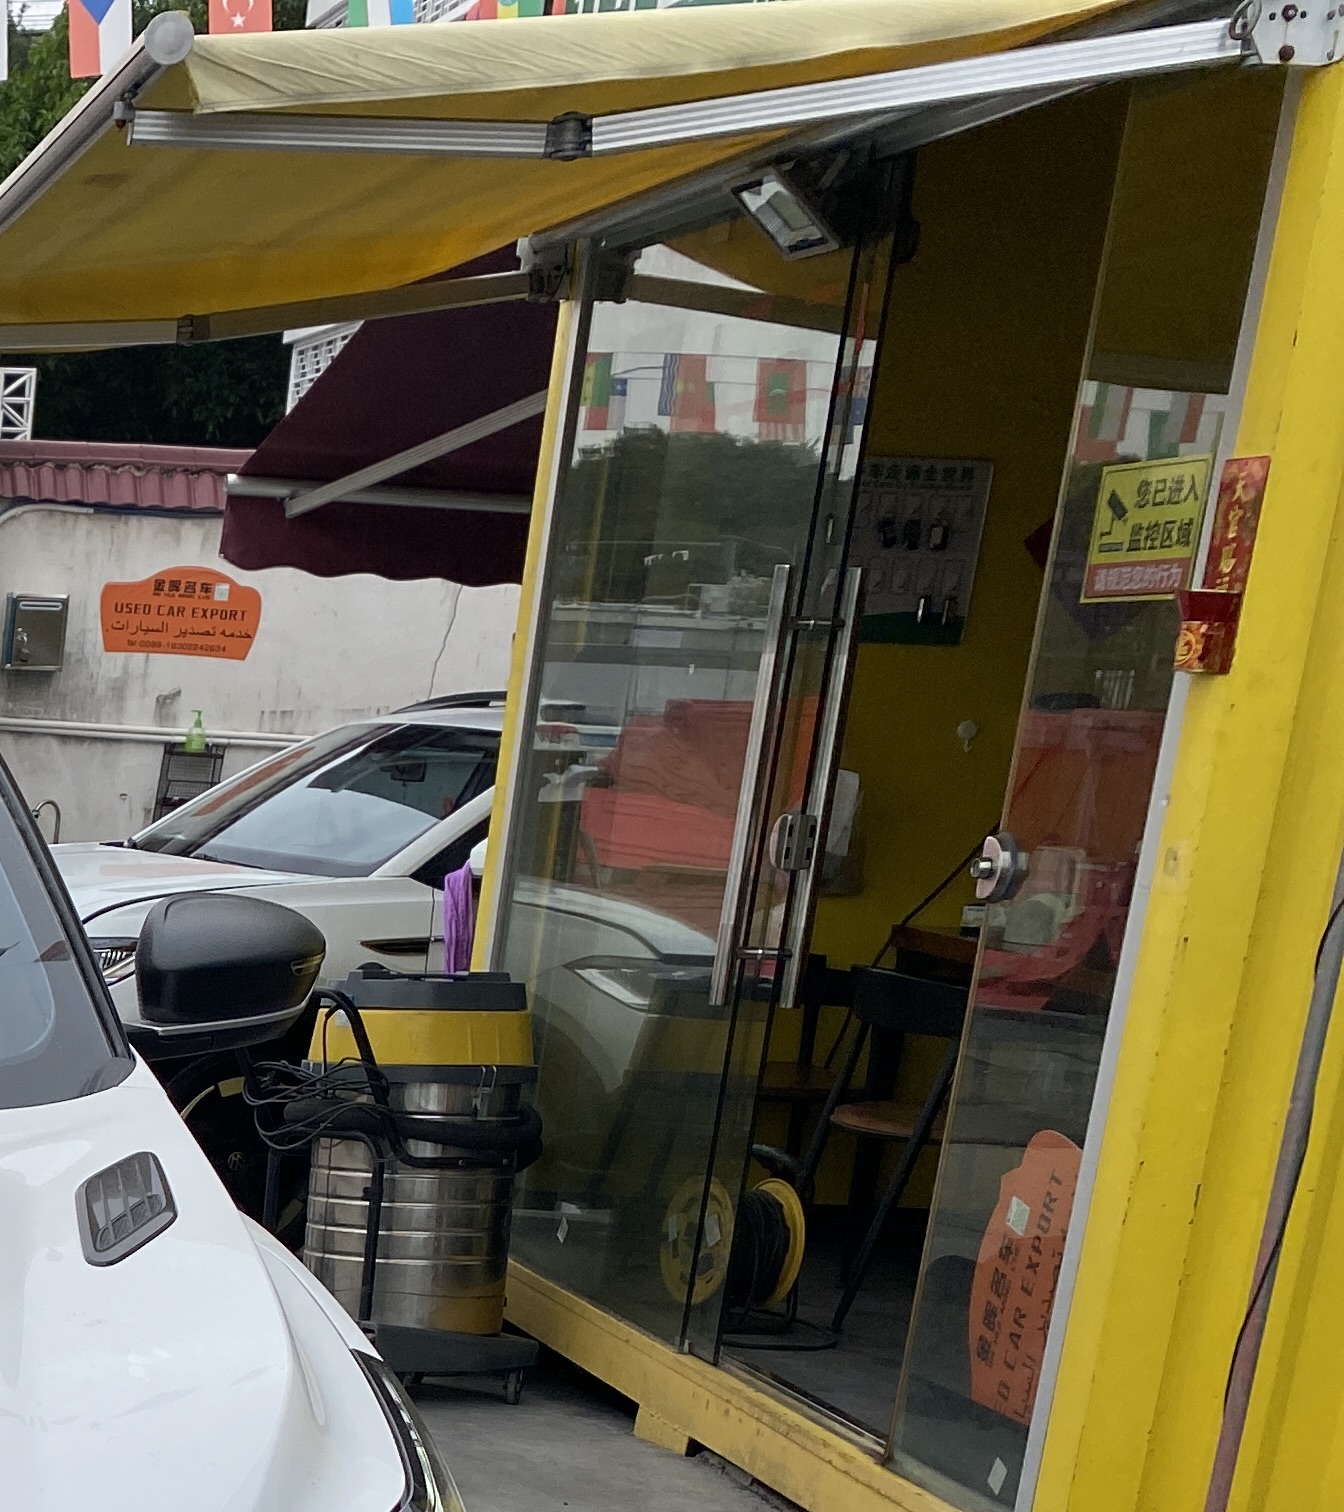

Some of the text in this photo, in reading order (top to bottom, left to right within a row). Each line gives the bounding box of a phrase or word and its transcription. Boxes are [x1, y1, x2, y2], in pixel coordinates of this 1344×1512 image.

[1134, 474, 1199, 509] 您已进入
[1126, 517, 1194, 553] 监控区域
[114, 602, 248, 622] USED CAR EXPORT
[1004, 1306, 1028, 1371] CAR
[1020, 1168, 1063, 1296] EXPORT
